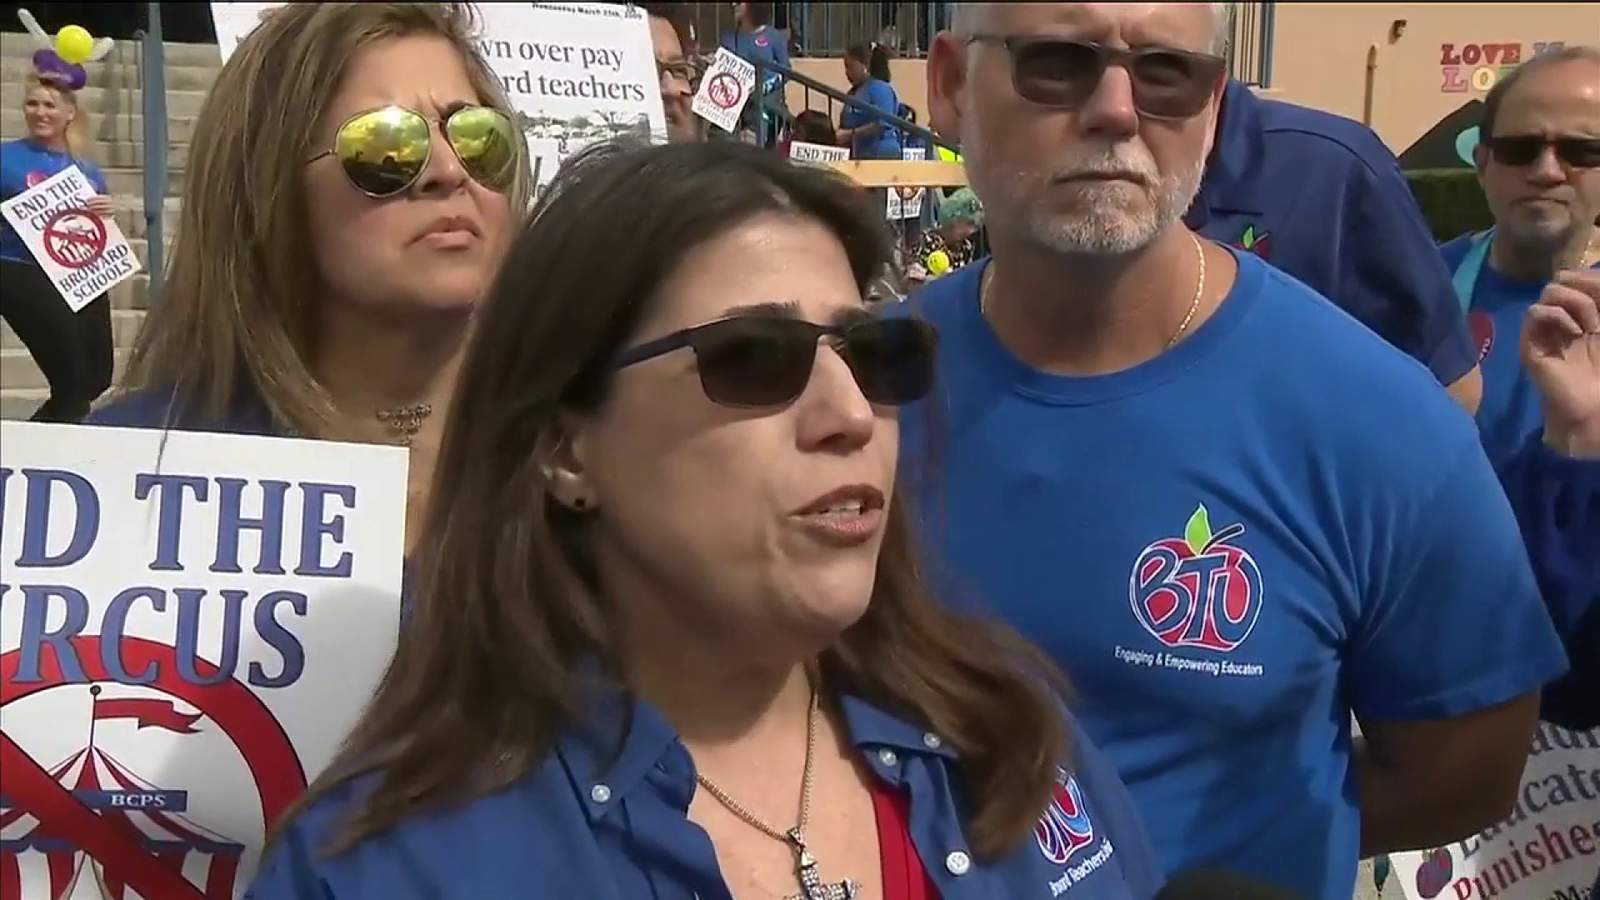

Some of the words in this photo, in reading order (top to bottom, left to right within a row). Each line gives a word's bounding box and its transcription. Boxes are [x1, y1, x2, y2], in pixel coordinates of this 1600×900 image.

[519, 41, 574, 63] over
[581, 48, 624, 72] pay
[1440, 43, 1521, 65] LOVE
[538, 74, 645, 102] teachers
[796, 146, 820, 160] END
[822, 150, 845, 160] THE
[12, 193, 48, 220] END
[49, 174, 82, 198] THE
[30, 192, 88, 231] CIRCUS
[59, 243, 129, 292] BROWARD
[73, 258, 133, 303] SCHOOLS
[0, 468, 101, 568] D
[135, 473, 356, 578] THE
[1132, 545, 1263, 648] BTU
[1115, 646, 1154, 667] Engaging
[1155, 655, 1163, 666] &
[1165, 653, 1220, 677] Empowering
[1221, 660, 1264, 677] Educators
[111, 794, 167, 807] BCPS
